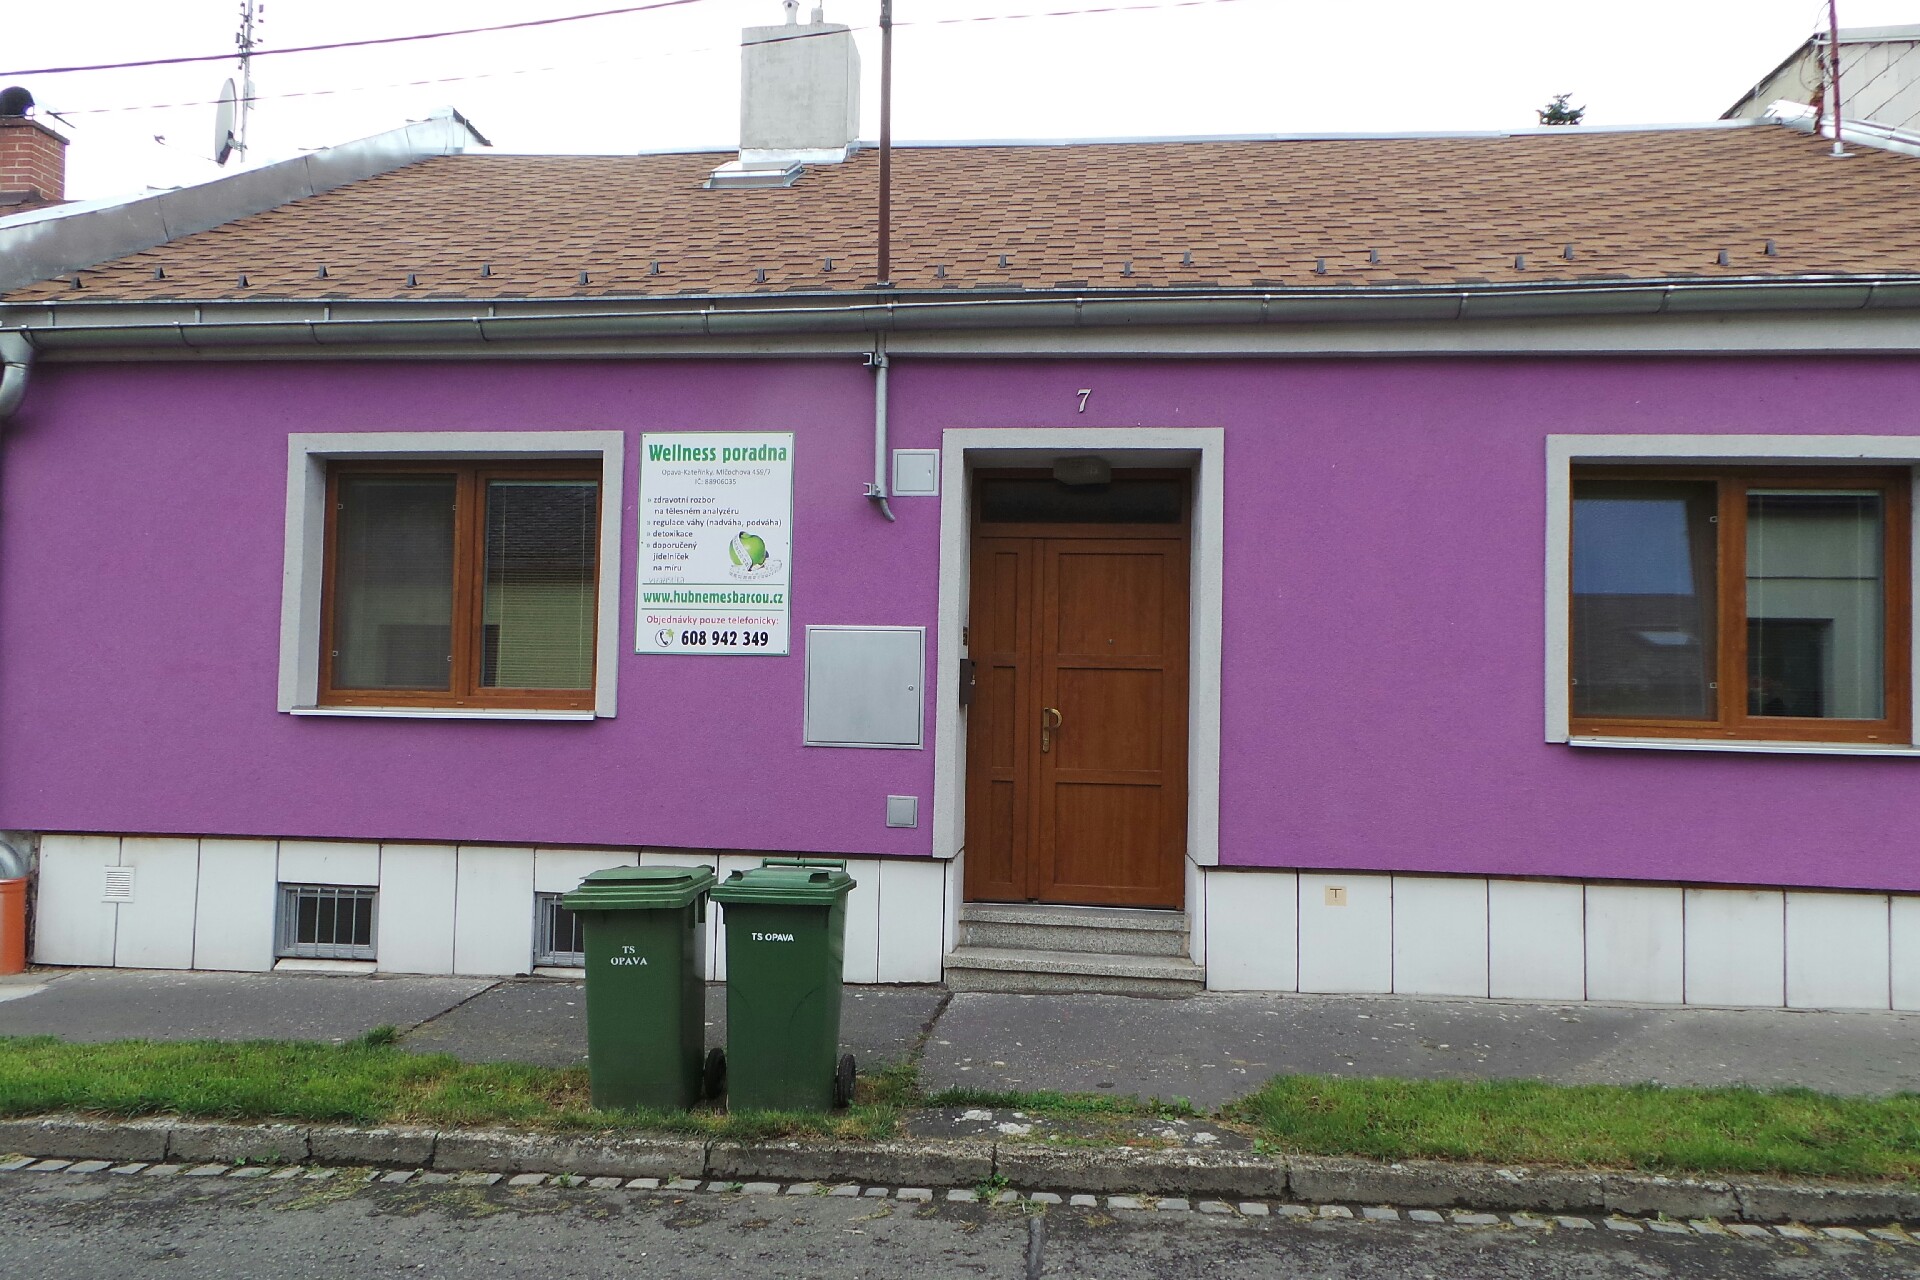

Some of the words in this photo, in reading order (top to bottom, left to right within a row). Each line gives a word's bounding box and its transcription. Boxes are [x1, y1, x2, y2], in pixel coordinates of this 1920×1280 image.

[1077, 388, 1092, 413] 7
[648, 444, 717, 462] Wellness
[722, 444, 787, 463] poradna
[653, 496, 689, 504] zdravotní
[690, 496, 715, 504] rozbor
[666, 507, 701, 515] tělesném
[702, 507, 739, 517] analyzéru
[653, 519, 685, 528] regulace
[686, 518, 704, 528] váhy
[706, 518, 745, 528] (nadváha,
[746, 518, 782, 529] podváha)
[652, 530, 693, 538] detoxikace
[652, 541, 698, 551] doporučený
[652, 552, 689, 562] jídelníček
[664, 563, 682, 571] míru
[643, 590, 784, 604] www.hubnemesbarcou.cz
[646, 615, 697, 625] Objednávky
[699, 617, 725, 625] pouze
[728, 616, 779, 626] telefonicky:
[681, 630, 707, 646] 608
[712, 631, 738, 646] 942
[742, 631, 769, 647] 349
[751, 932, 763, 942] TS
[764, 933, 795, 942] OPAVA
[622, 945, 635, 954] TS
[610, 957, 648, 966] OPAVA
